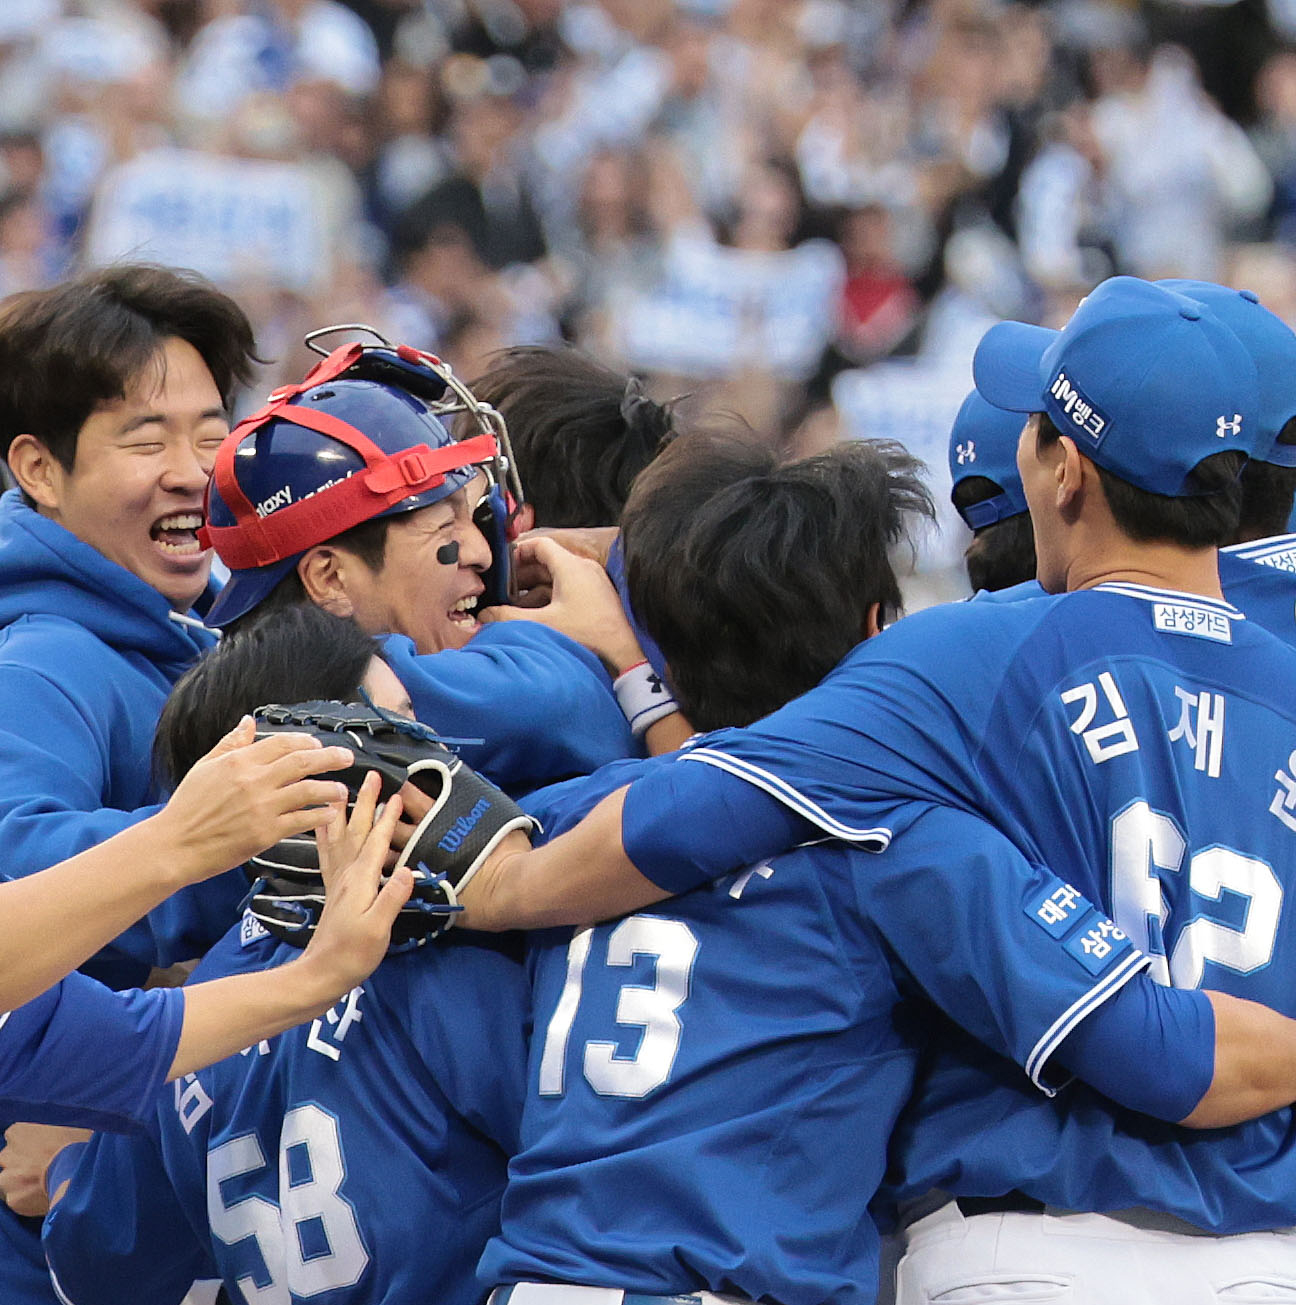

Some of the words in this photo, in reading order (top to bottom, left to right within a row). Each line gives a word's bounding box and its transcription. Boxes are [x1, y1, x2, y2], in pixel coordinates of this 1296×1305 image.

[1051, 373, 1105, 439] iM뱅크
[1160, 607, 1227, 633] 삼성카드
[437, 796, 492, 853] Wilson
[538, 915, 699, 1098] 13
